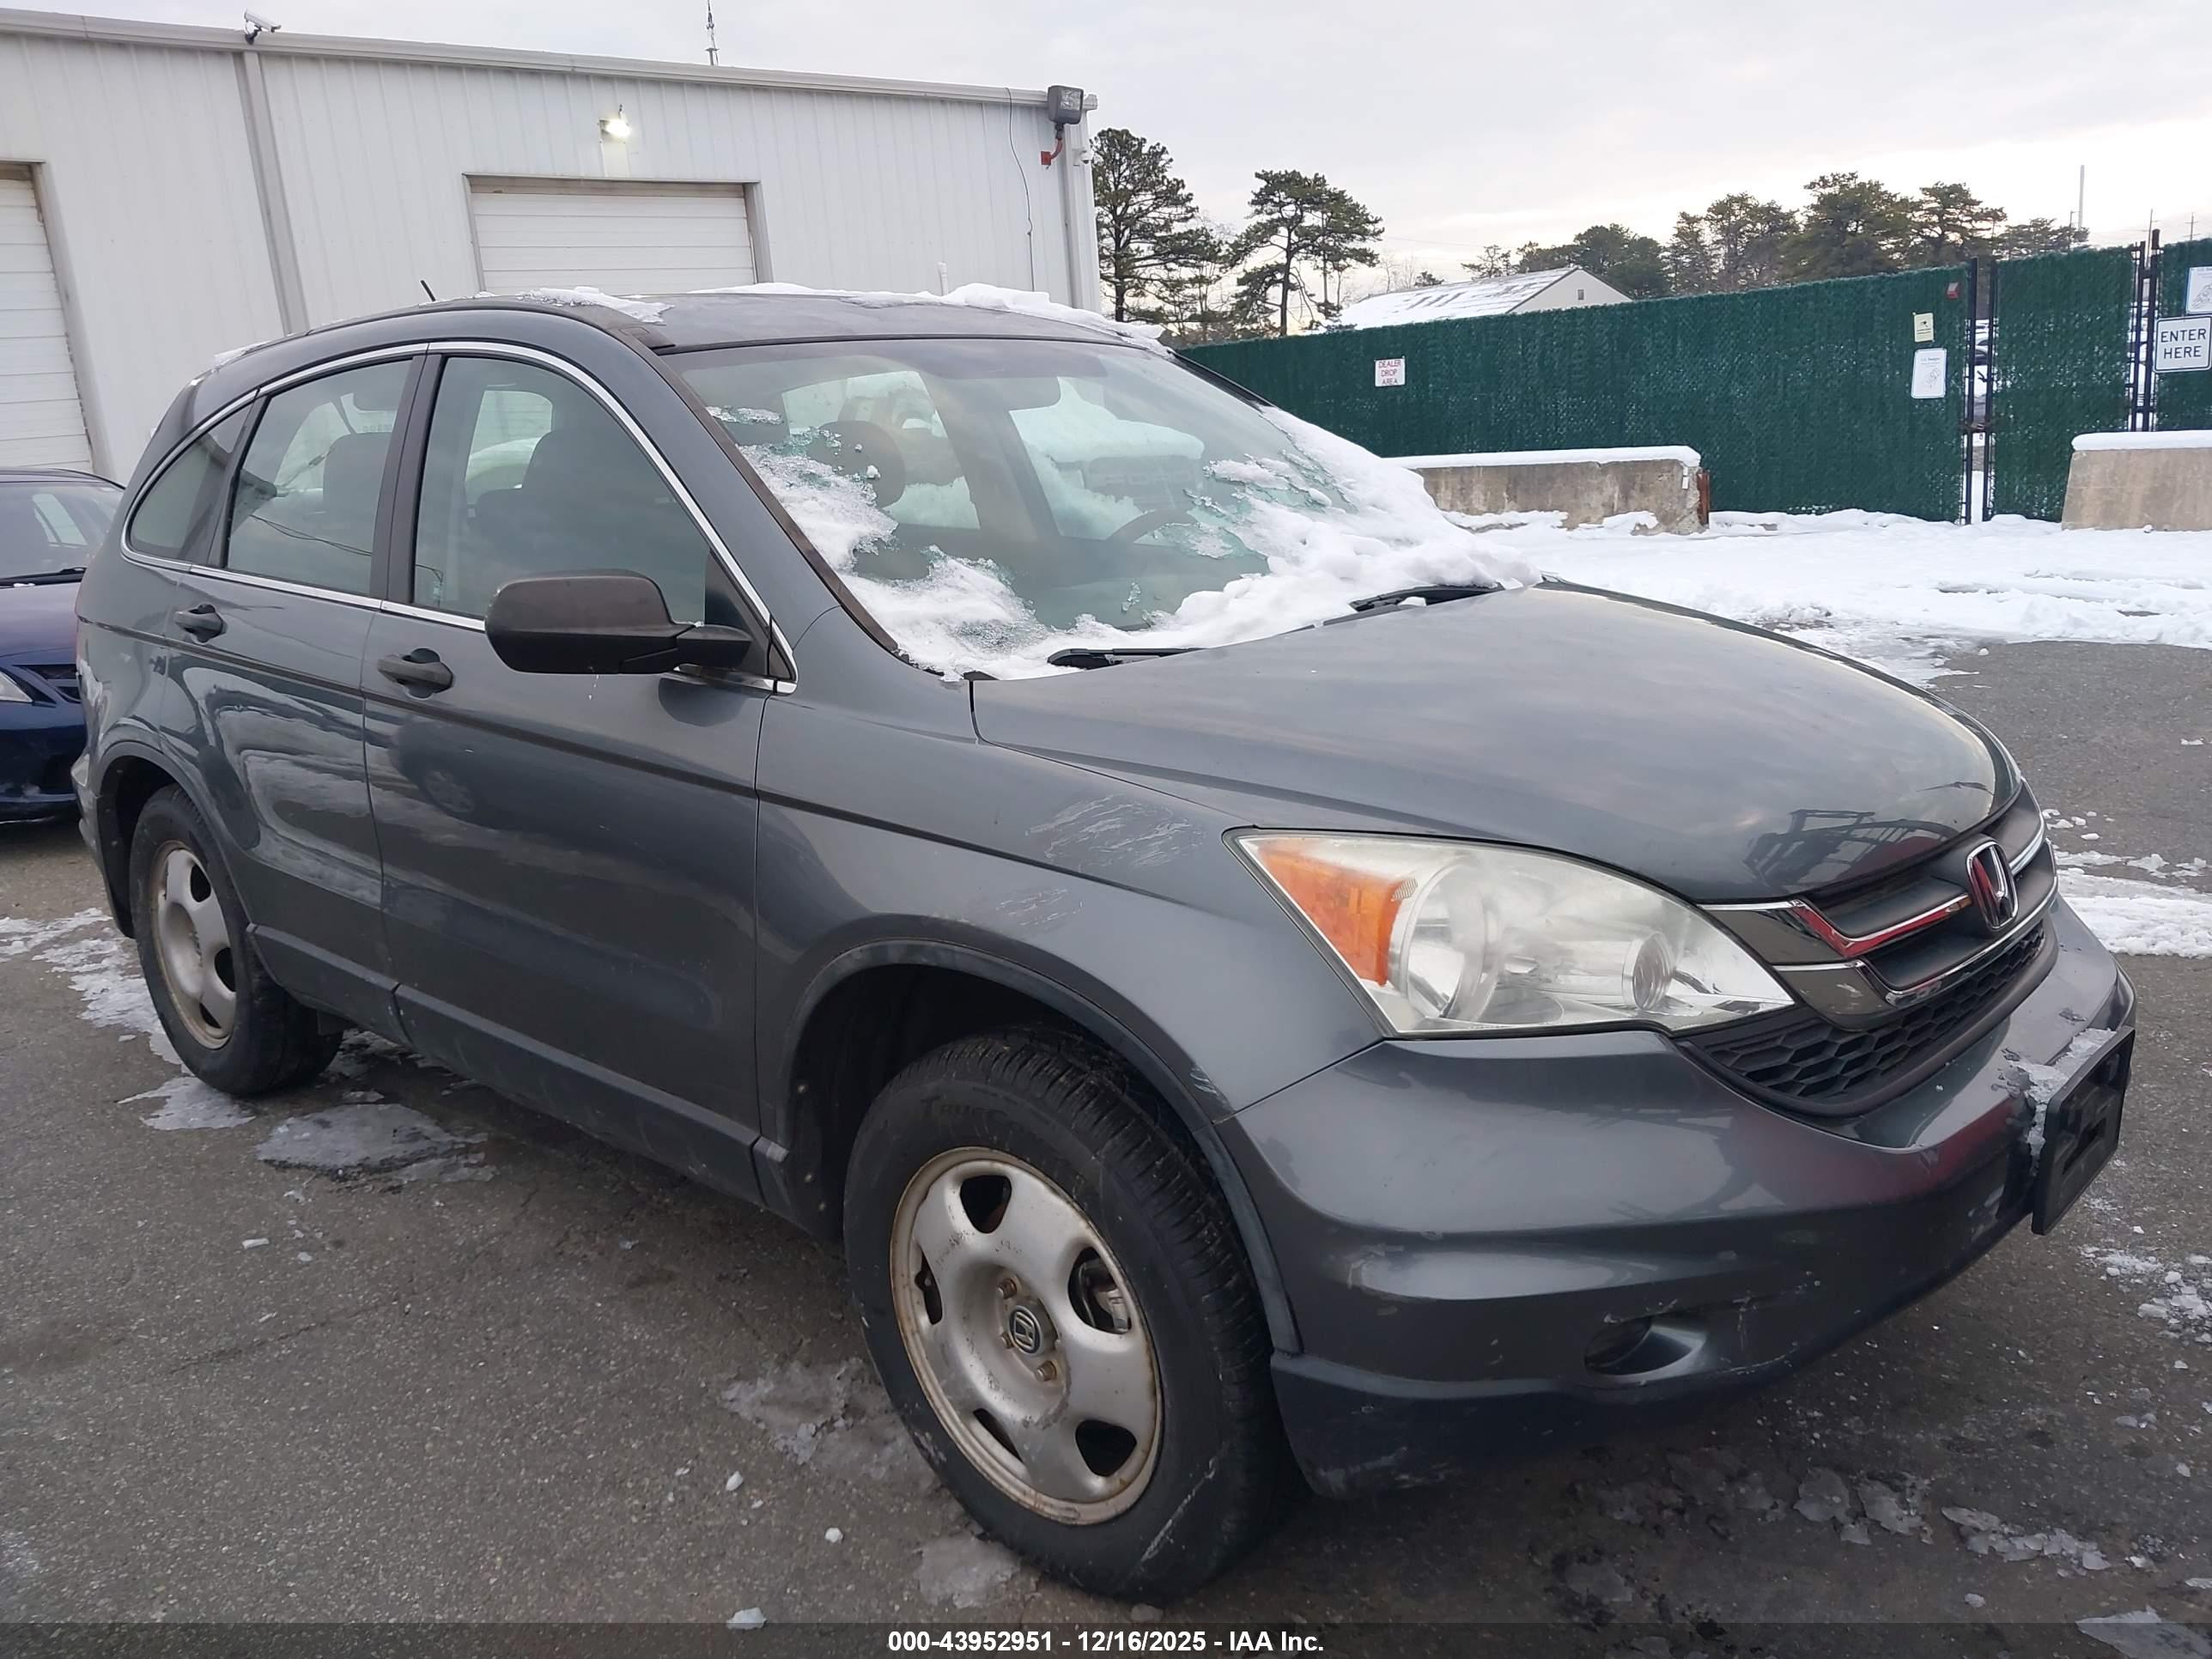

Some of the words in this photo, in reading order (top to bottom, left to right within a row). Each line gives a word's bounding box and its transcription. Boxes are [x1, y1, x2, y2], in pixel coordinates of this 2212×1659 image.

[2160, 328, 2207, 343] ENTER
[2164, 345, 2202, 359] HERE
[1378, 359, 1401, 368] DEALER
